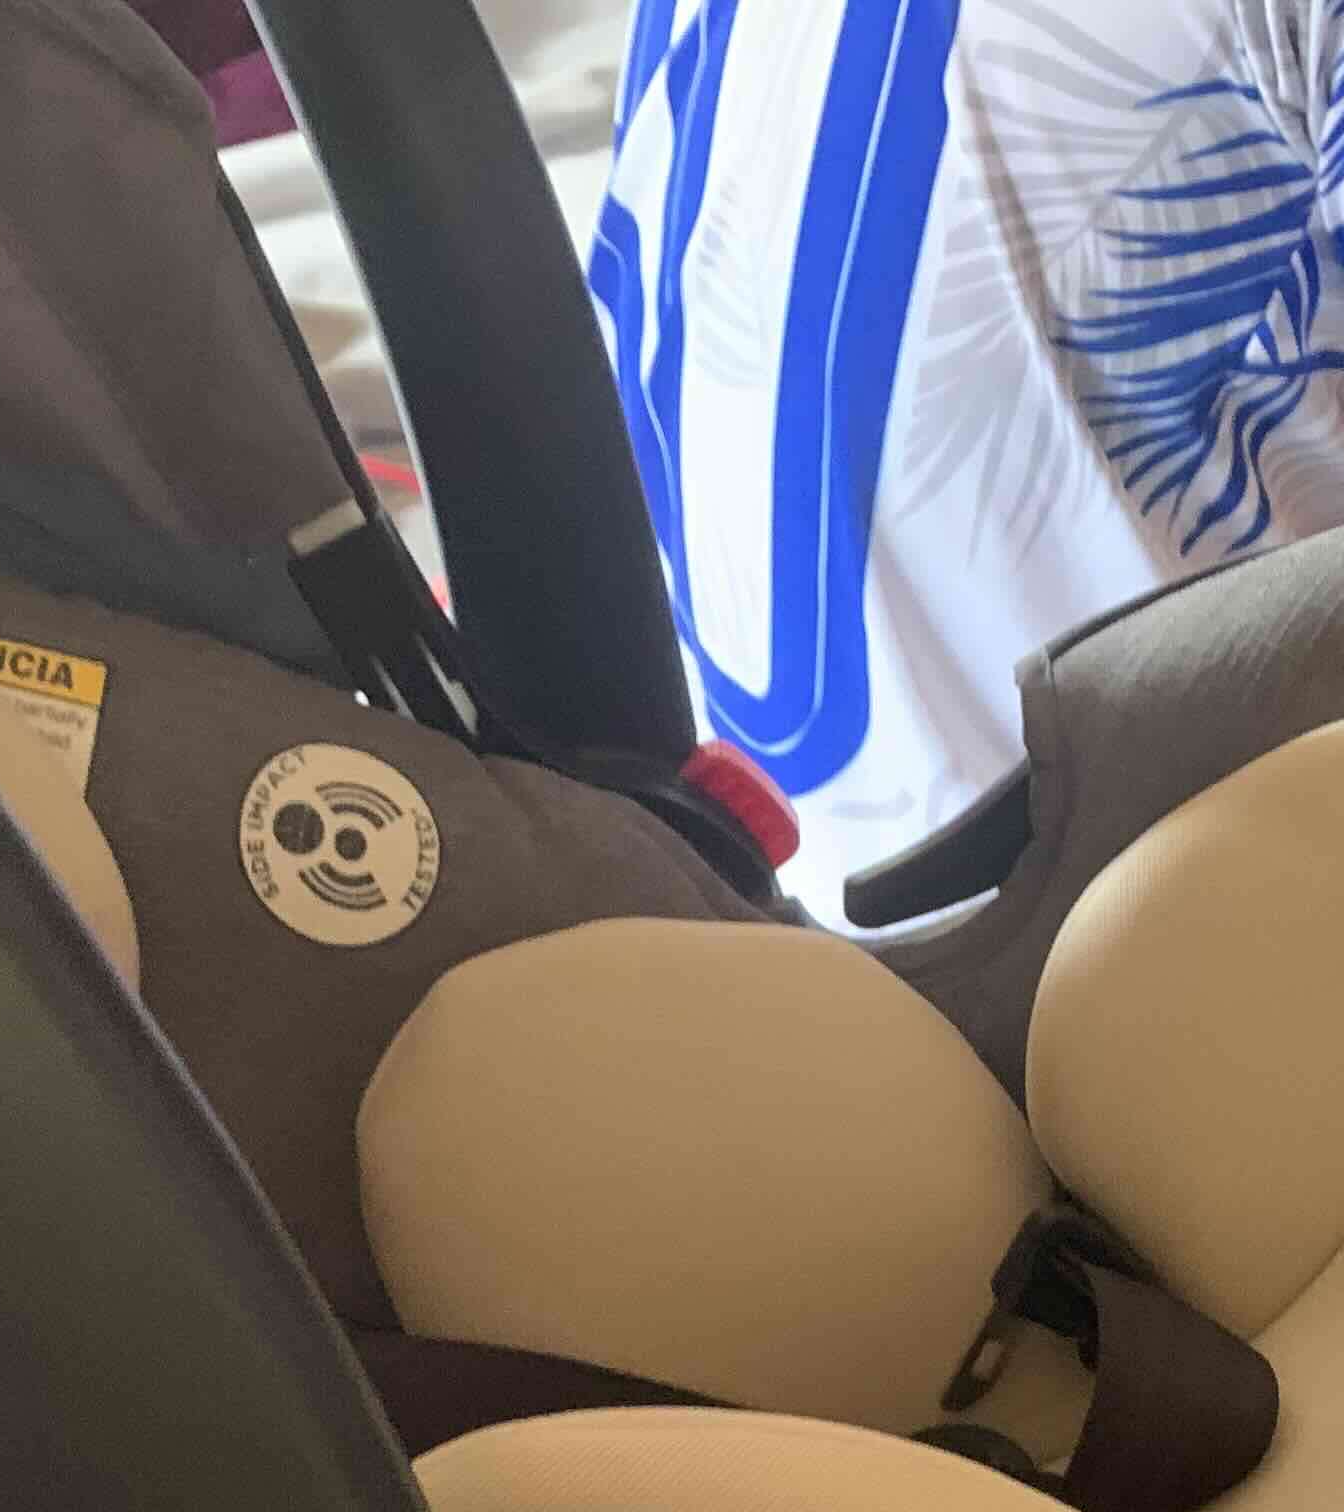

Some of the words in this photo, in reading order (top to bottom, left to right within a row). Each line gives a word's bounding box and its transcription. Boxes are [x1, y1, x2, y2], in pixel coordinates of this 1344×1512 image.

[246, 748, 305, 831] IMPACT
[247, 839, 280, 898] SIDE
[402, 814, 436, 911] TESTED
